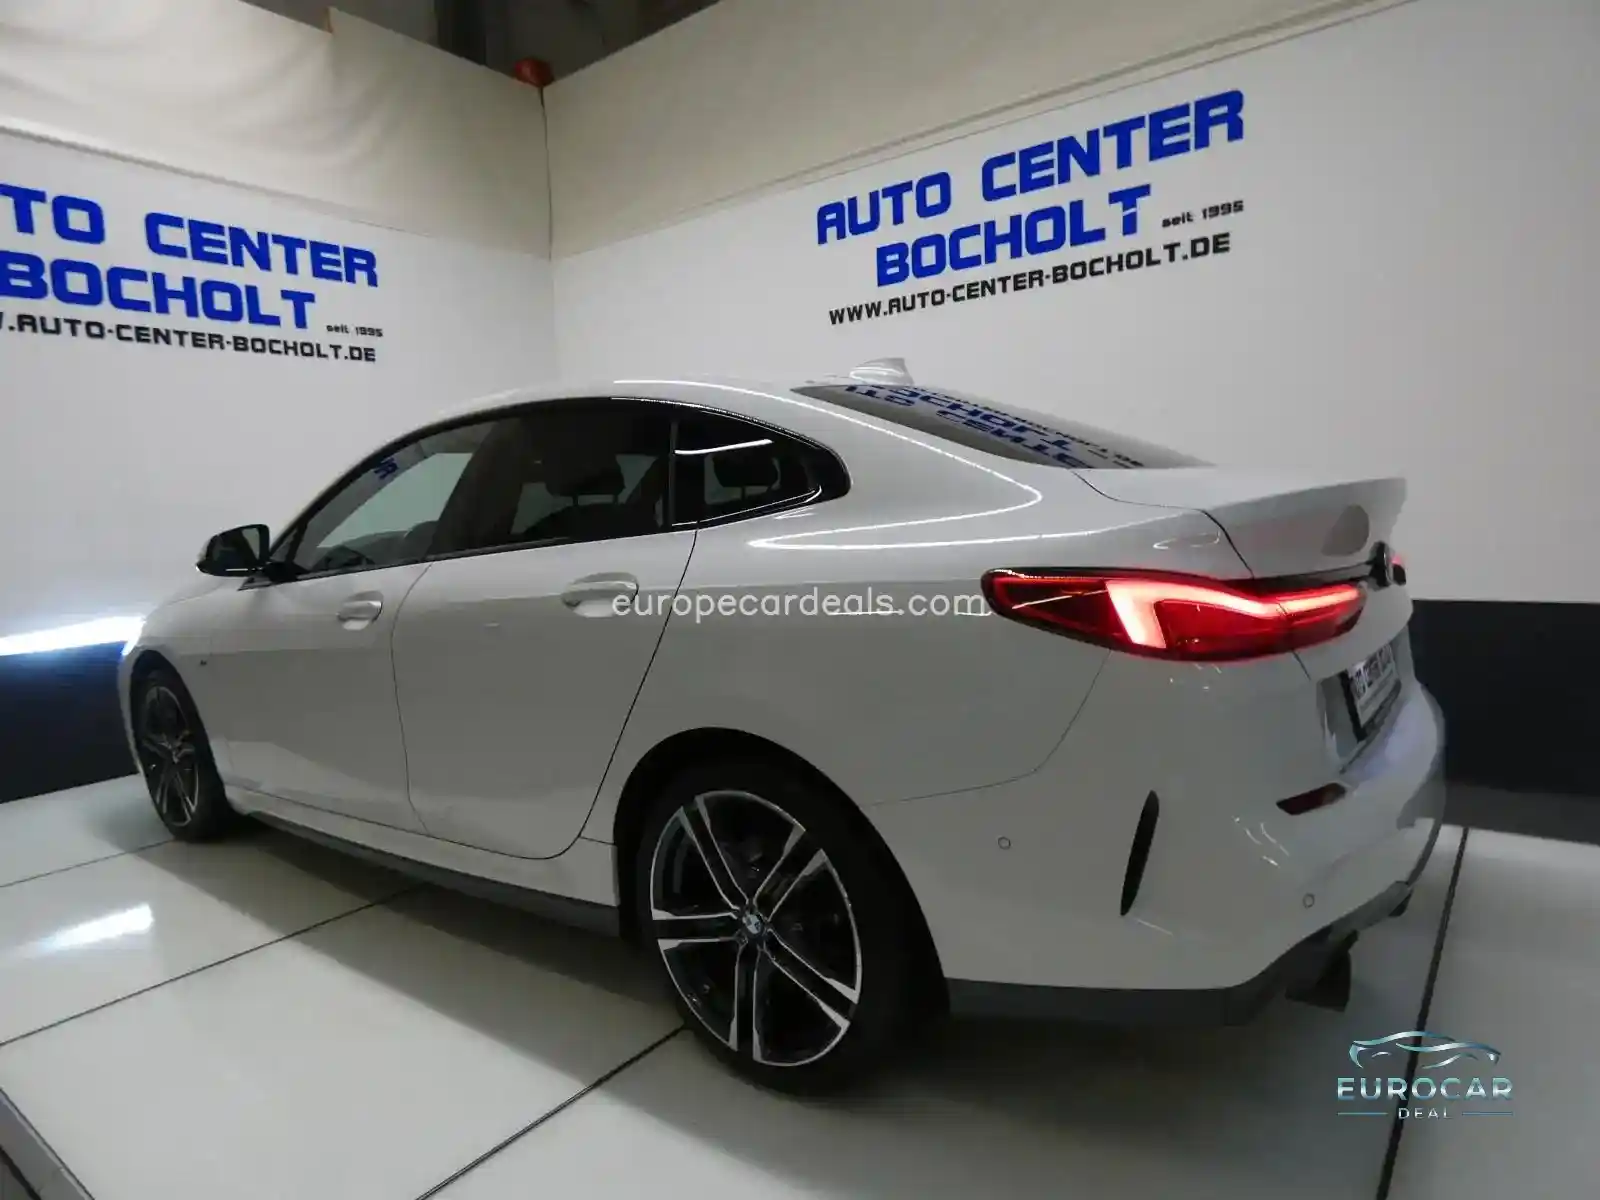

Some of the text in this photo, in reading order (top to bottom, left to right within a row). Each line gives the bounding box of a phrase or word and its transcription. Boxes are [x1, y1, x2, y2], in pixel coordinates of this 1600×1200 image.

[816, 90, 1244, 245] AUTO CENTER
[144, 211, 379, 288] CENTER
[829, 232, 1231, 325] WWW.AUTO-CENTER-BOCHOLT.DE
[876, 184, 1244, 287] BOCHOLT seit 1995
[0, 249, 316, 329] BOCHOLT
[0, 311, 376, 363] .AUTO-CENTER-BOCHOLT.DE
